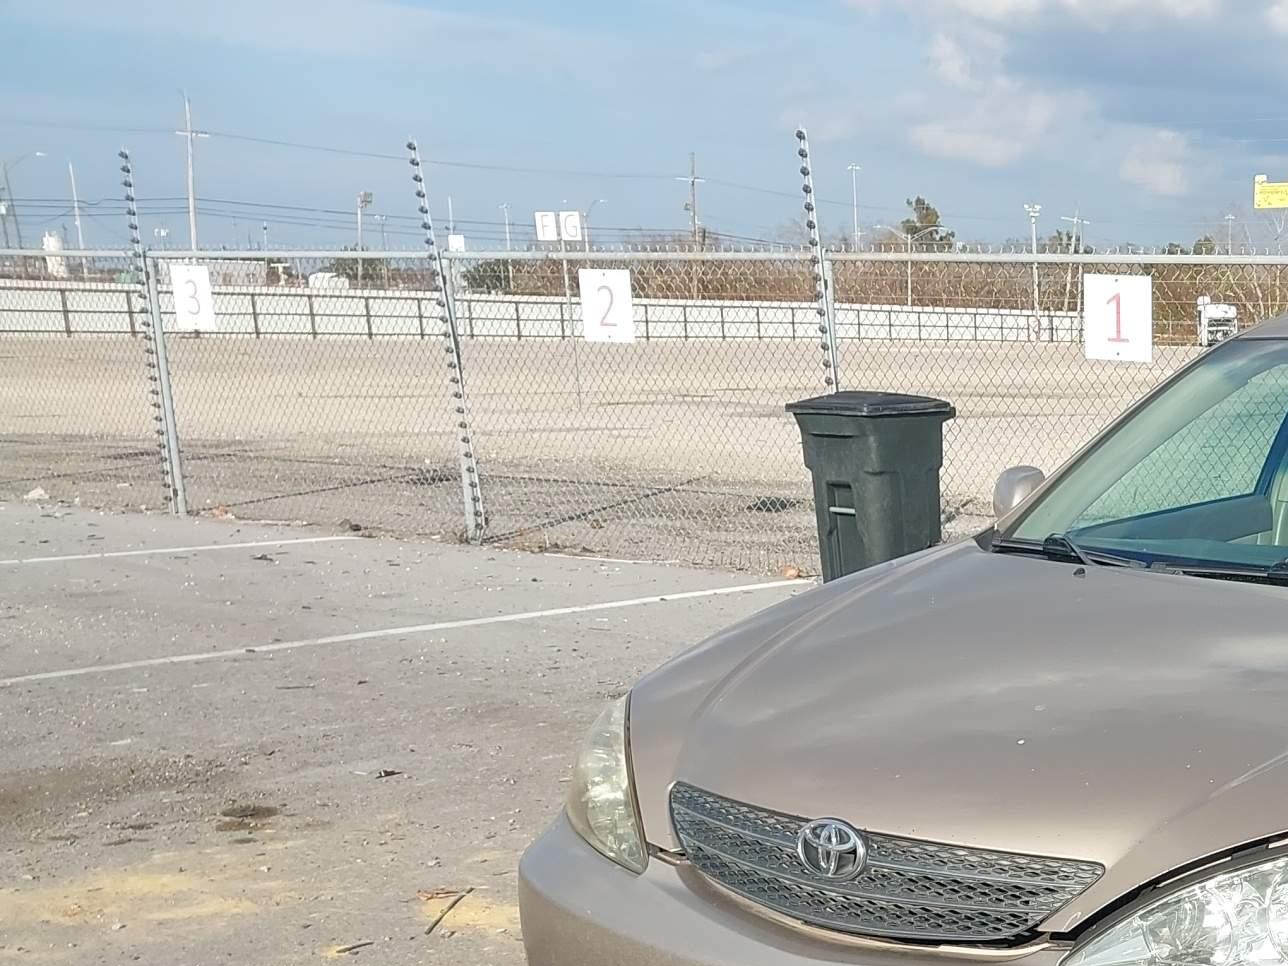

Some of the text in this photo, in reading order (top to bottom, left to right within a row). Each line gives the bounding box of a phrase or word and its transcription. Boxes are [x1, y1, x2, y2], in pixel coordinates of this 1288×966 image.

[540, 214, 550, 238] F
[564, 214, 579, 238] G
[184, 279, 201, 315] 3
[597, 285, 618, 327] 2
[1106, 292, 1130, 343] 1
